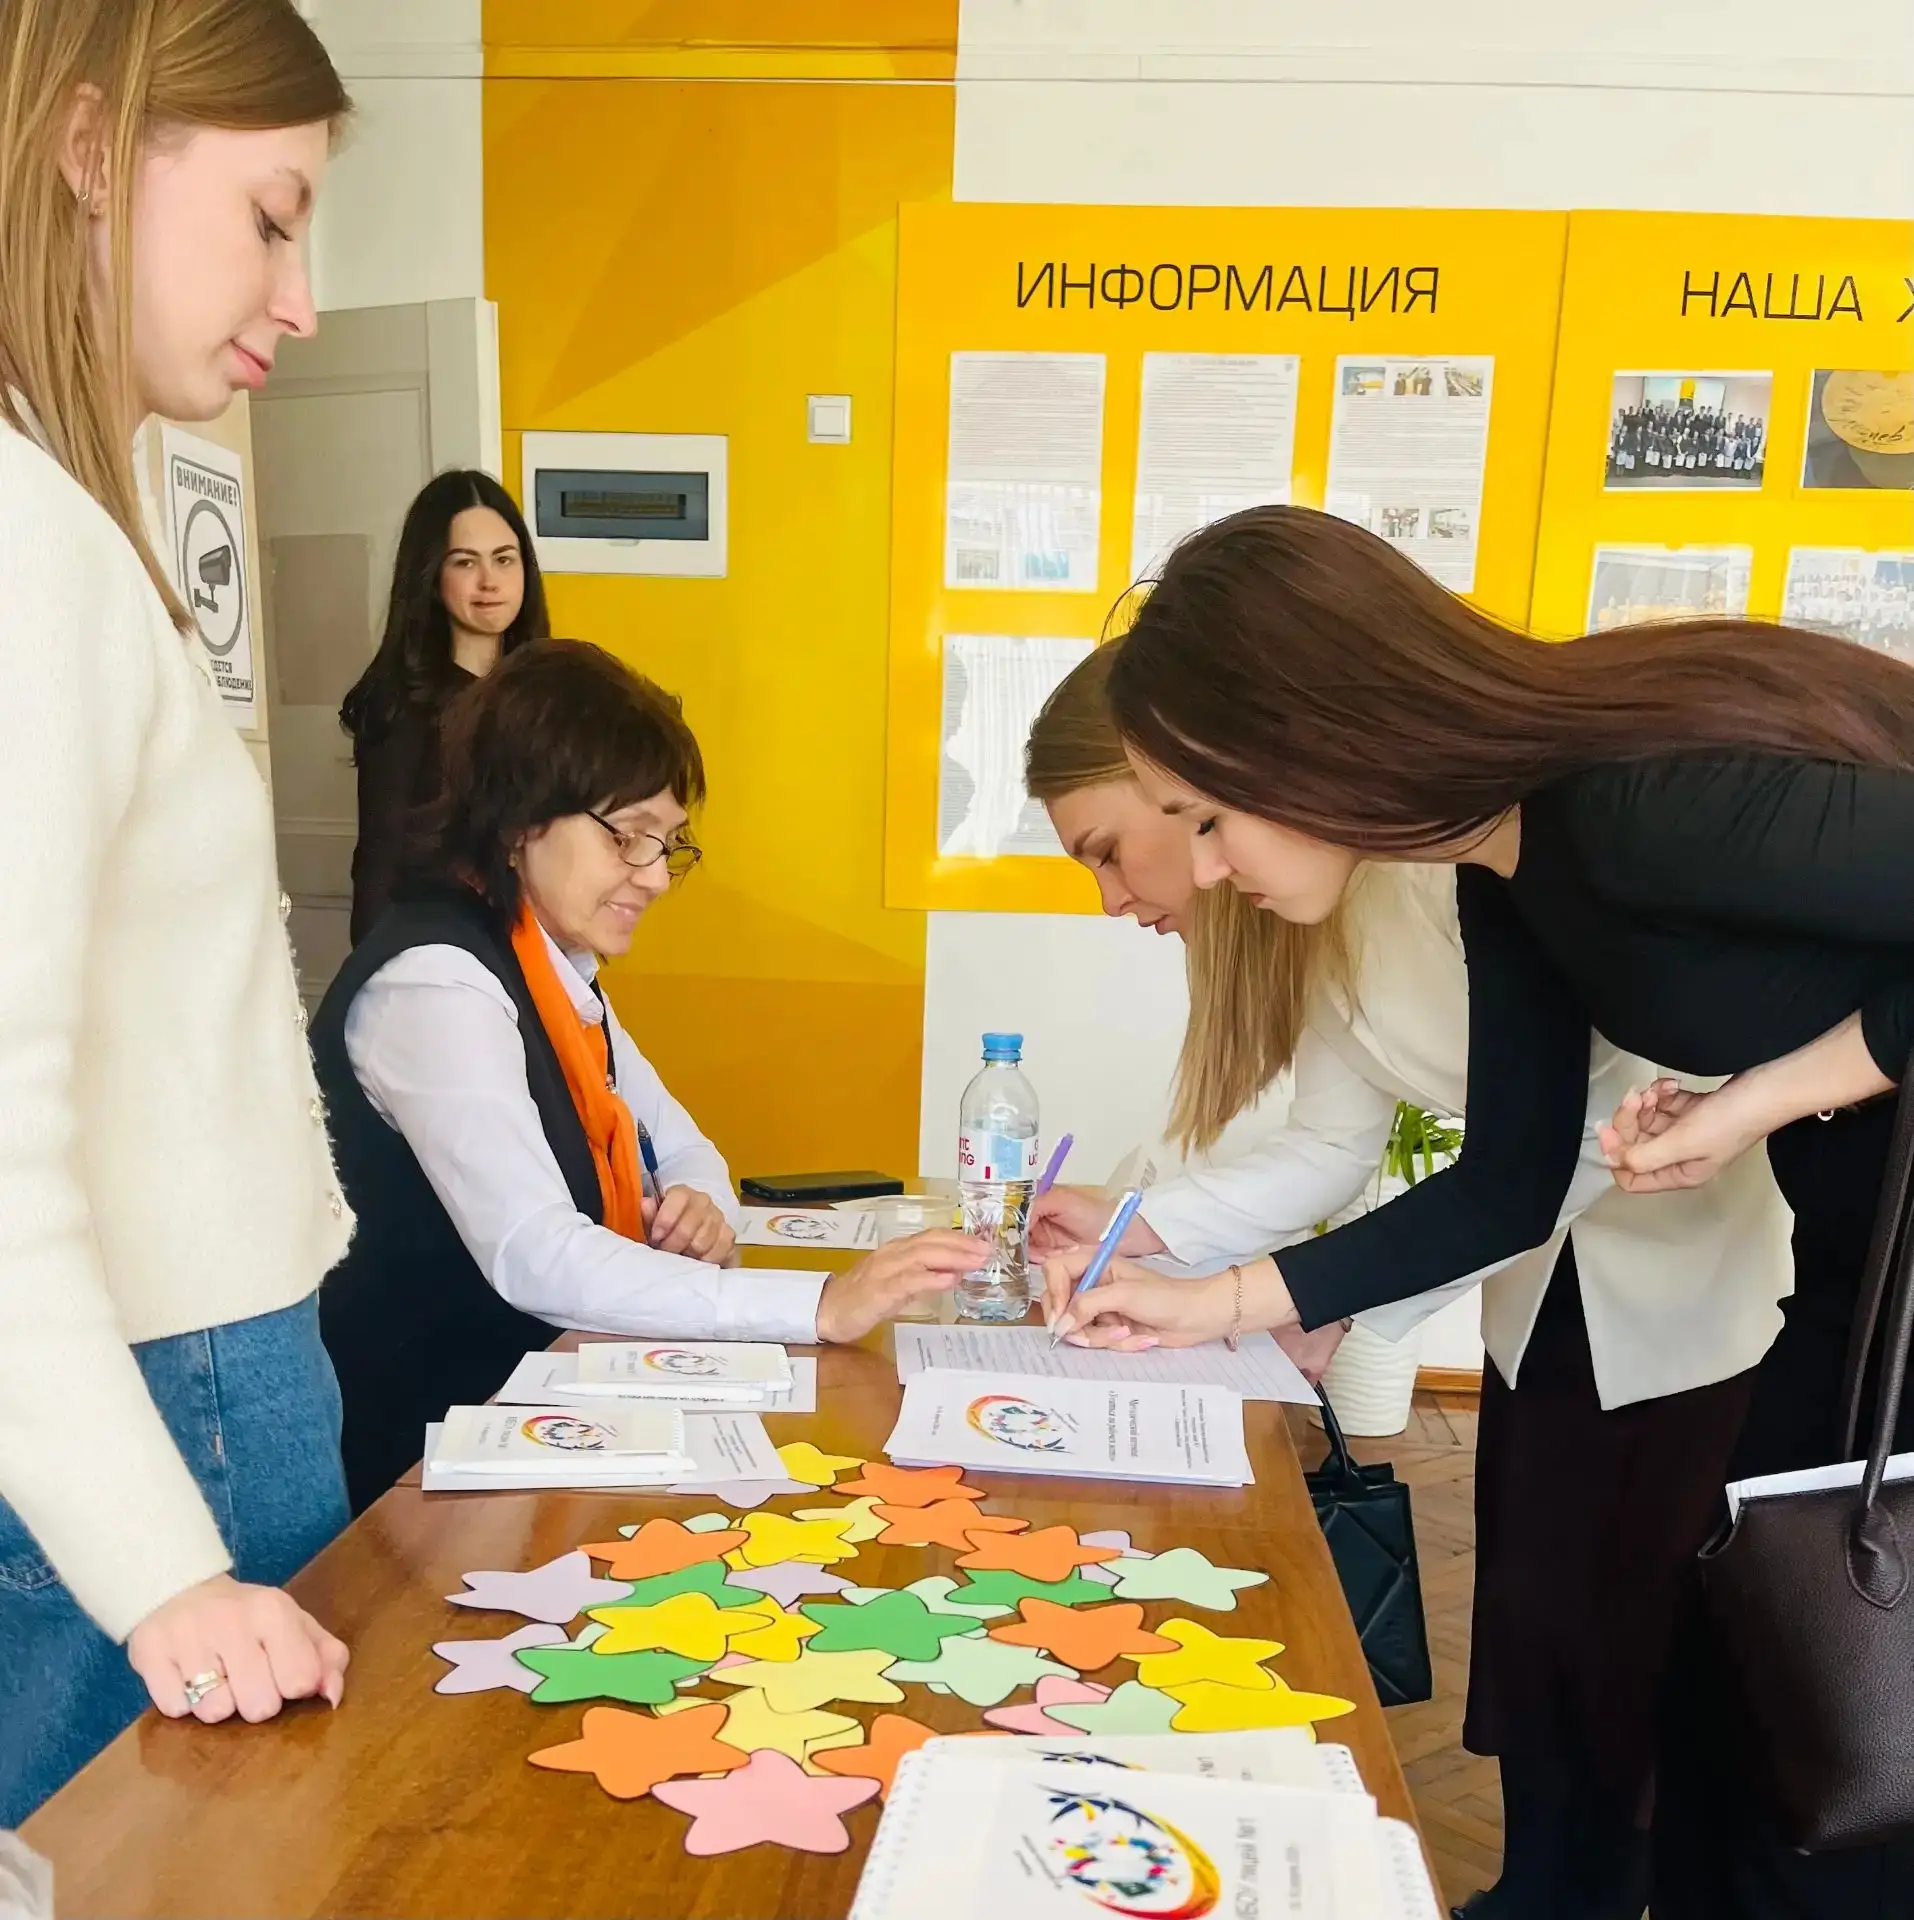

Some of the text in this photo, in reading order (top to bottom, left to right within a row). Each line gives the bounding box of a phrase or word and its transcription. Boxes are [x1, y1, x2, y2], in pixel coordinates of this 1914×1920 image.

[1016, 261, 1440, 321] ИНФОРМАЦИЯ
[1681, 271, 1863, 321] НАША
[176, 465, 238, 507] ВНИМАНИЕ!
